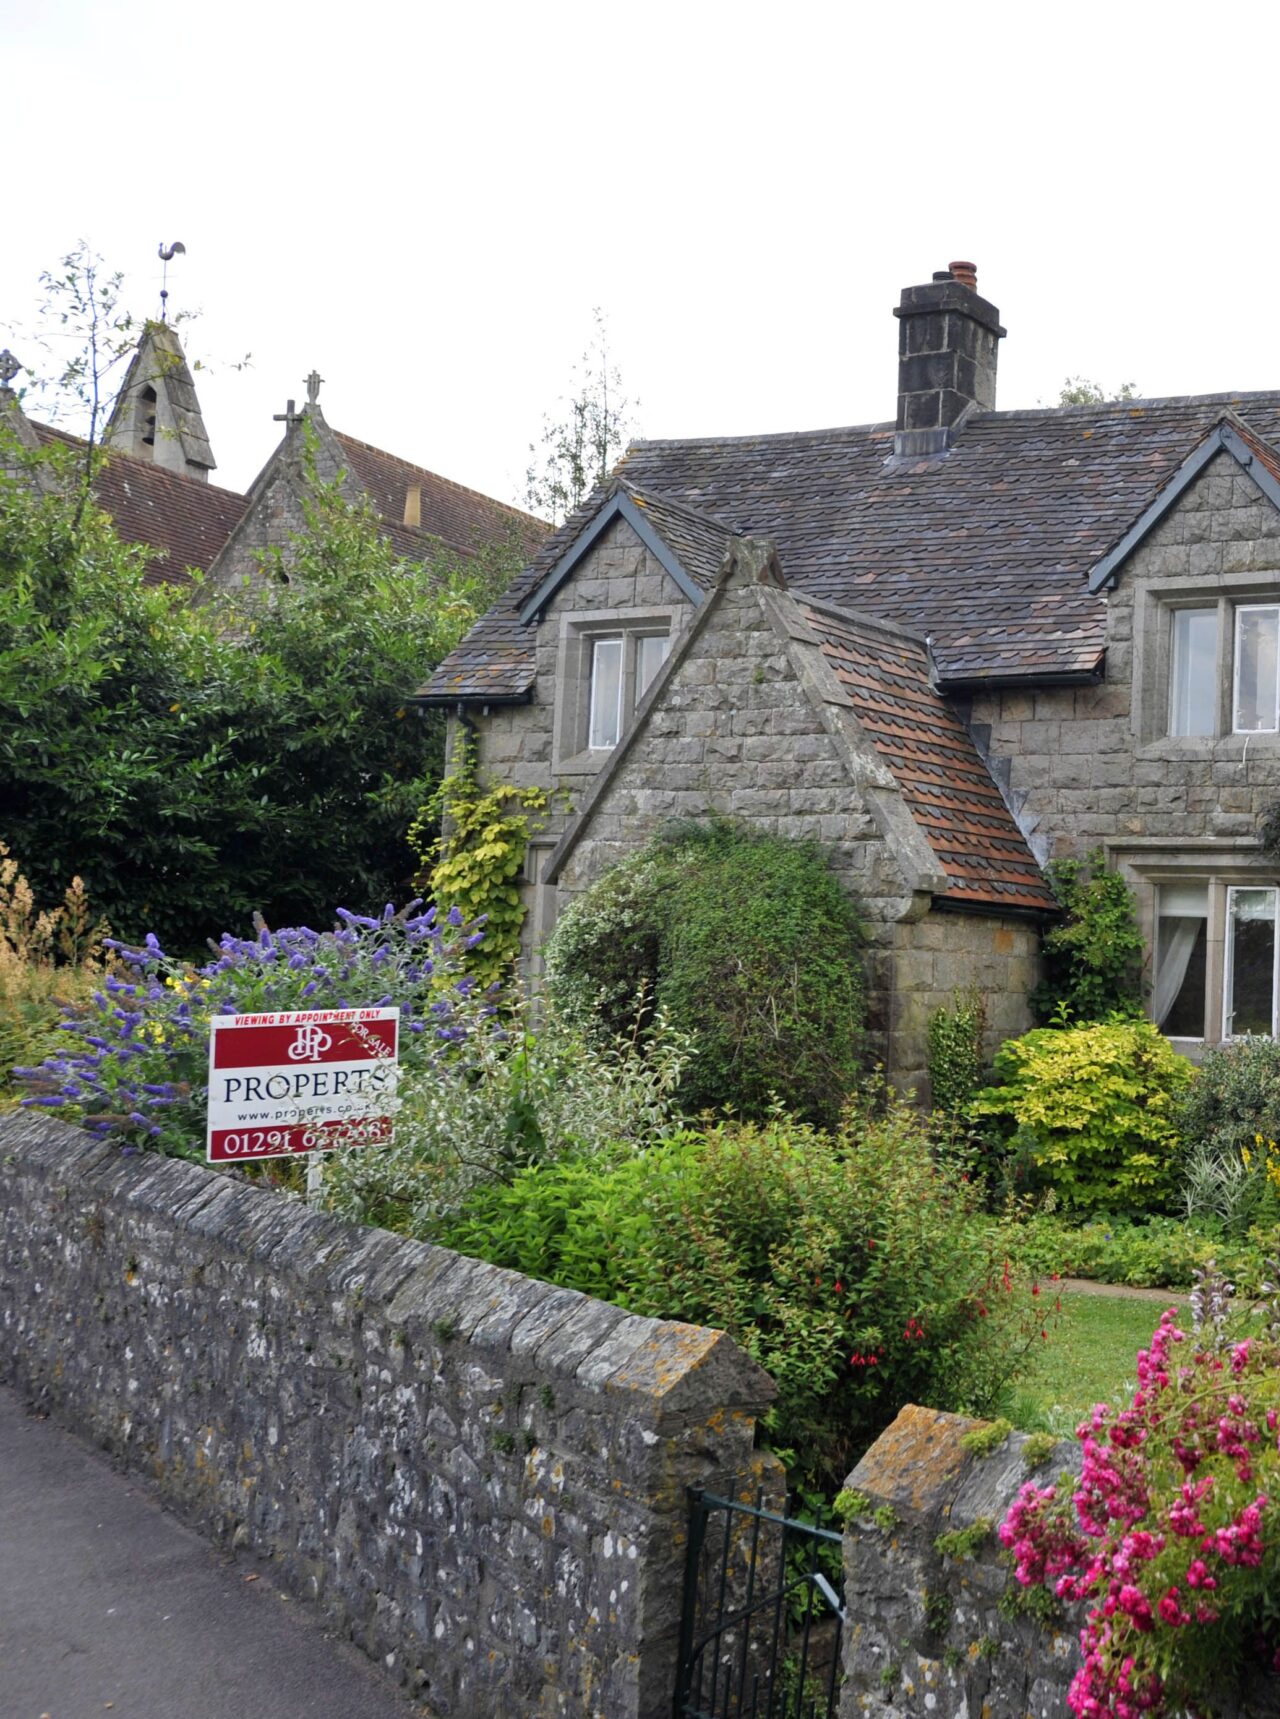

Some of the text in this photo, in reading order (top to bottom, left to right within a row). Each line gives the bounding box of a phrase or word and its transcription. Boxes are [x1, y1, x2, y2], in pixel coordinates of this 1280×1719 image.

[235, 1009, 382, 1026] VIEWING BY APPOINTMENT ONLY
[224, 1131, 295, 1154] 01291
